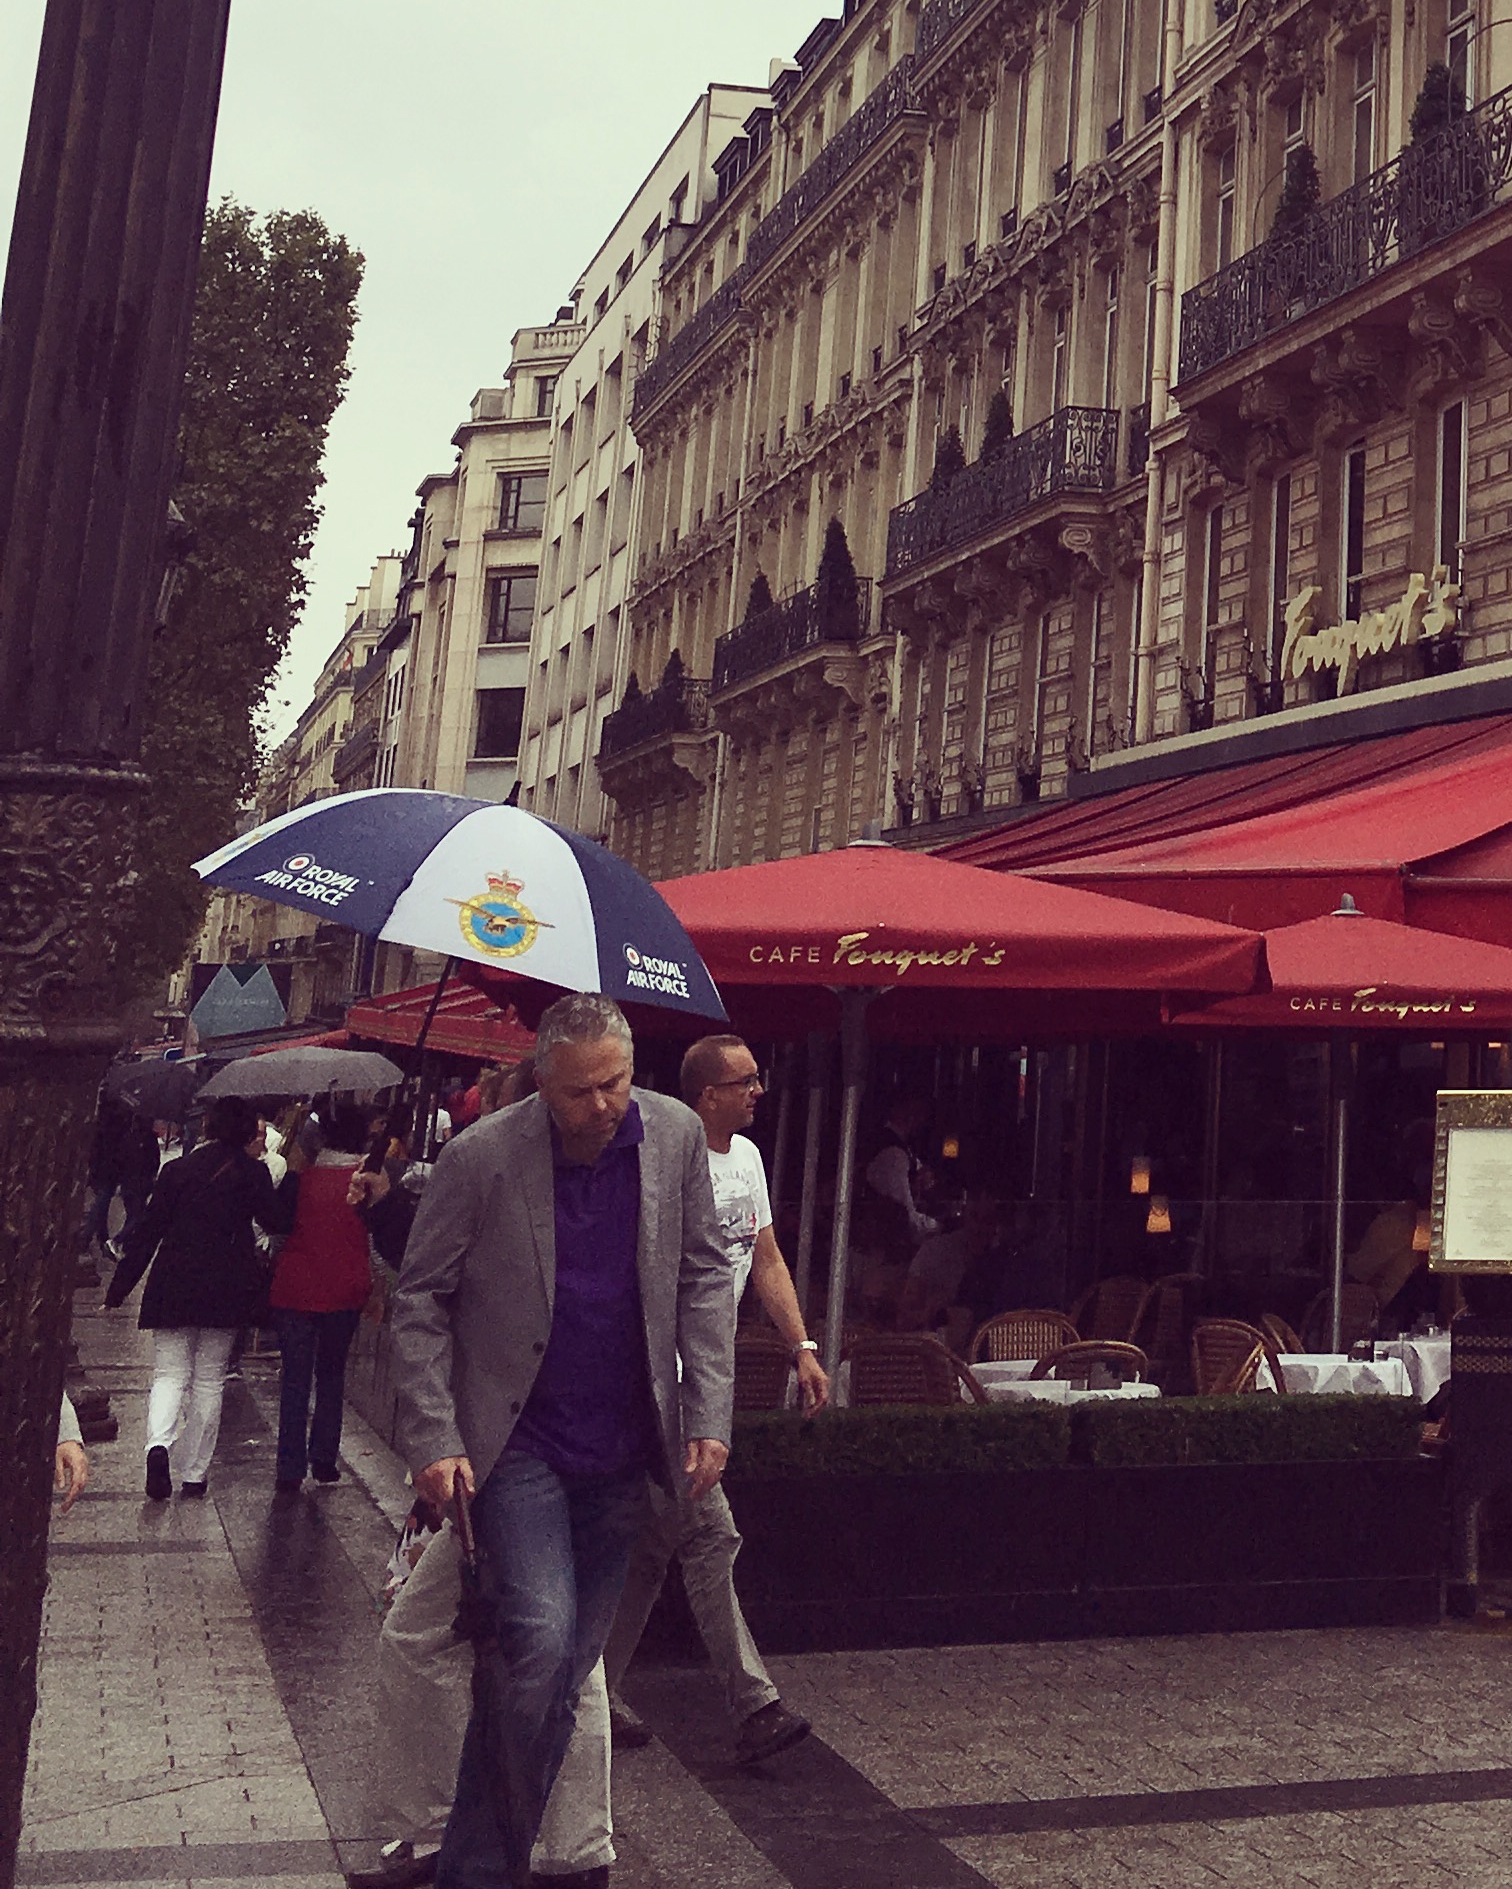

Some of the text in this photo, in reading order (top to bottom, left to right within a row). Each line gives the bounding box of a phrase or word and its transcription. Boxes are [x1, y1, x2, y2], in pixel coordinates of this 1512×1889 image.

[1280, 564, 1462, 697] Fouquet's
[254, 869, 350, 907] AIR FORCE
[302, 864, 360, 893] ROYAL
[642, 955, 686, 980] ROYAL
[749, 931, 1006, 976] CAFE Fouquet's
[626, 969, 691, 999] AIR FORCE
[1290, 997, 1342, 1011] CAFE
